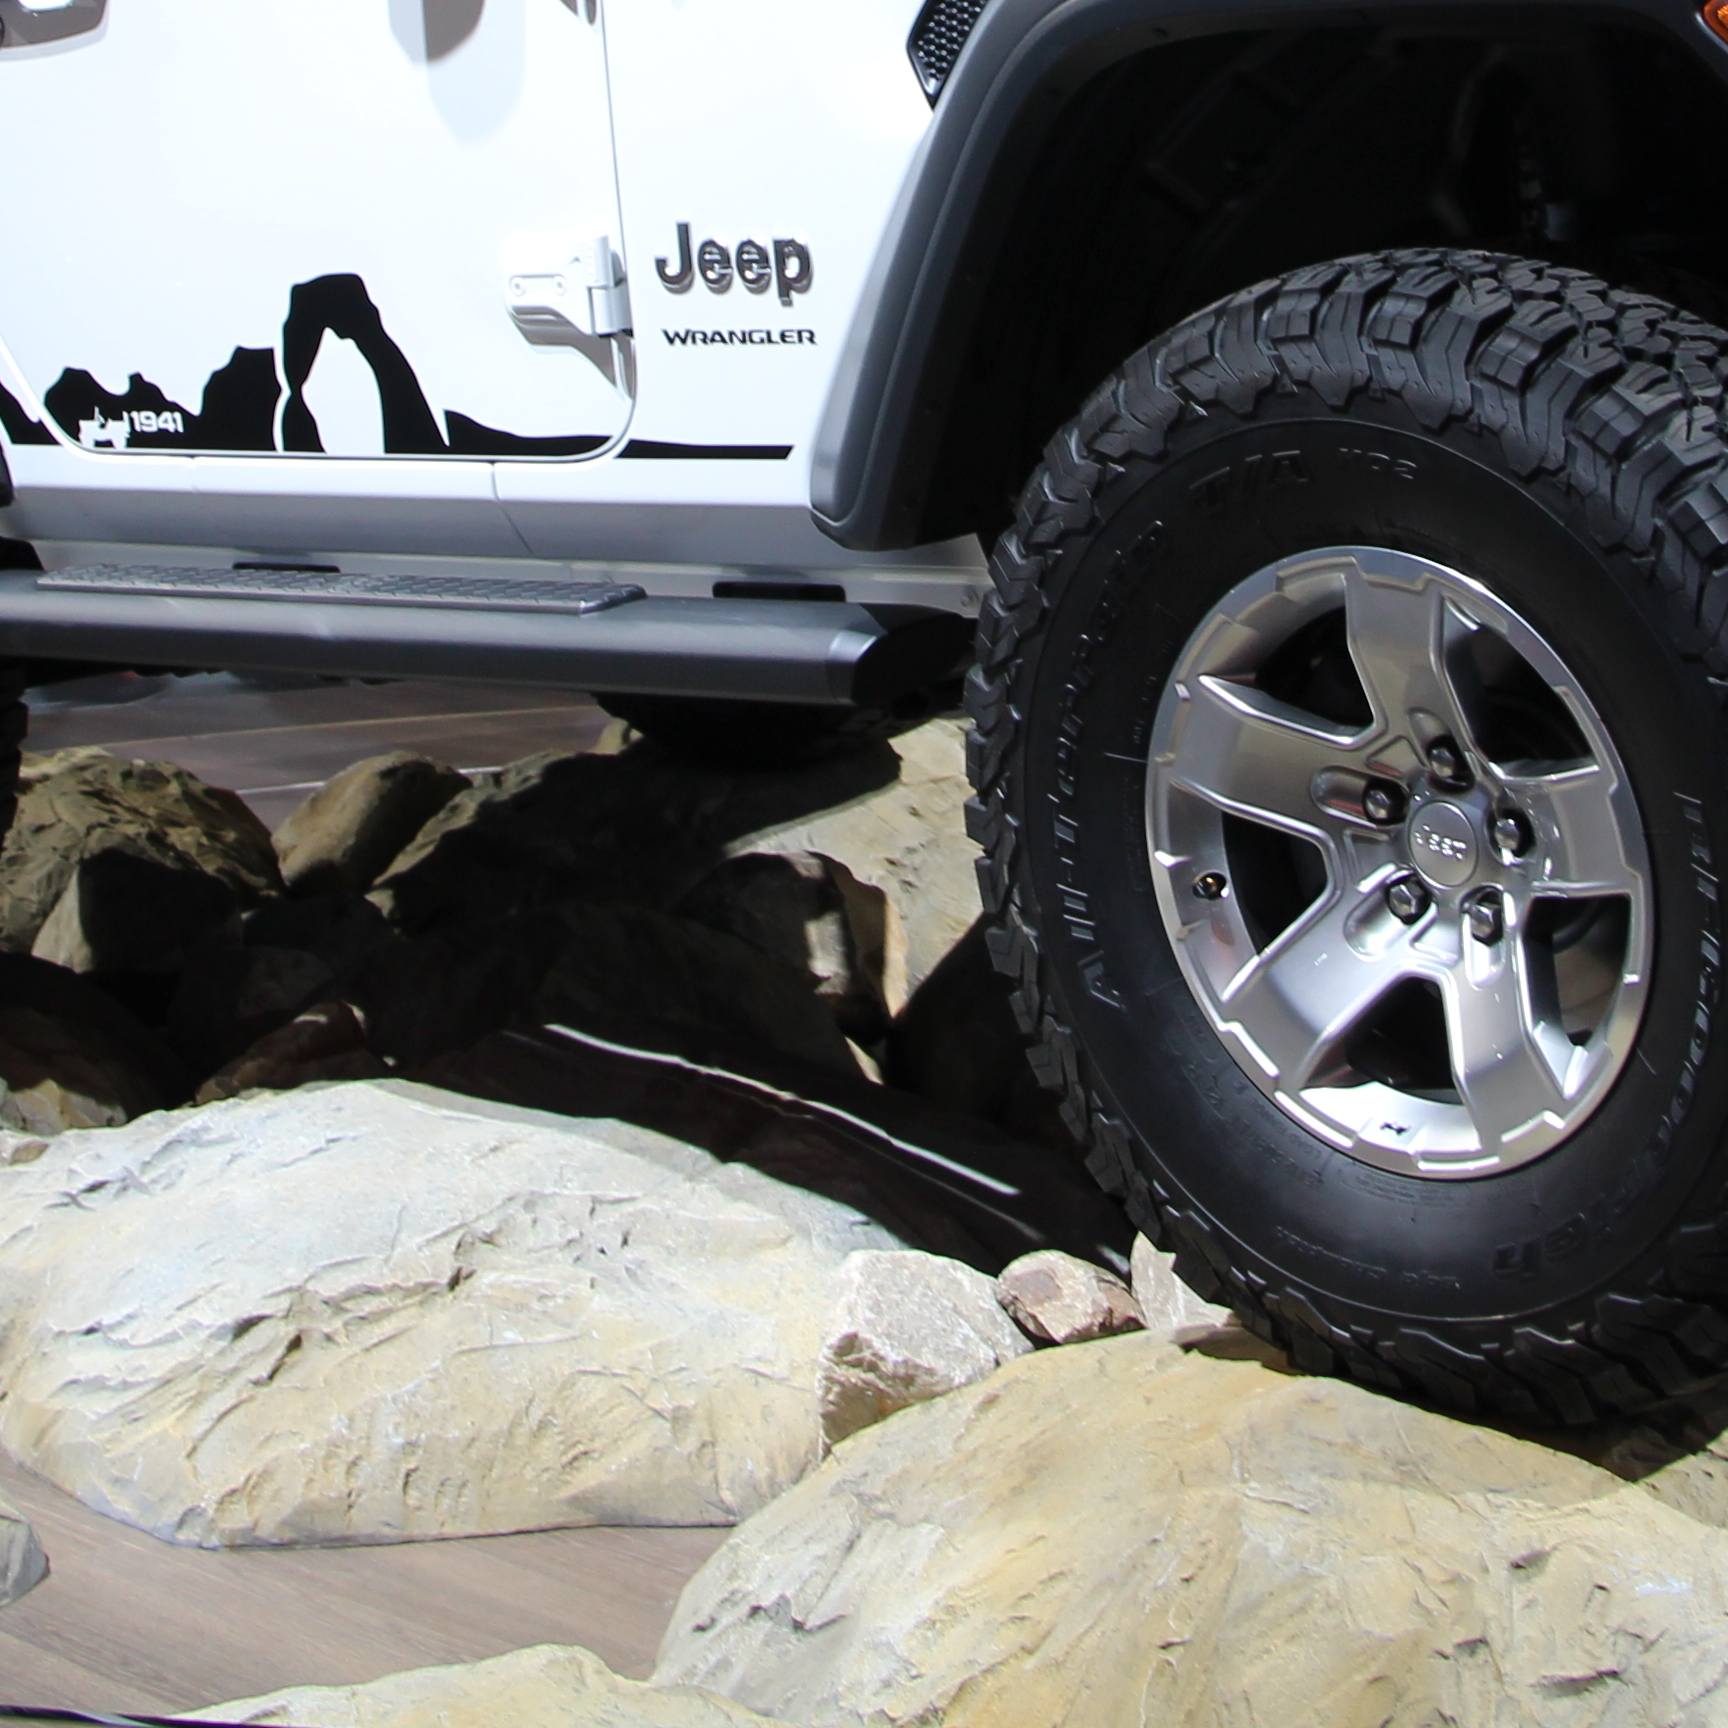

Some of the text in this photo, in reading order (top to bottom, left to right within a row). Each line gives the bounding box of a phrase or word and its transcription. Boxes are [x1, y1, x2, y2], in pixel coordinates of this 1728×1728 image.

[655, 222, 814, 307] Jeep
[661, 328, 817, 346] WRANGLER
[130, 410, 184, 433] 1941
